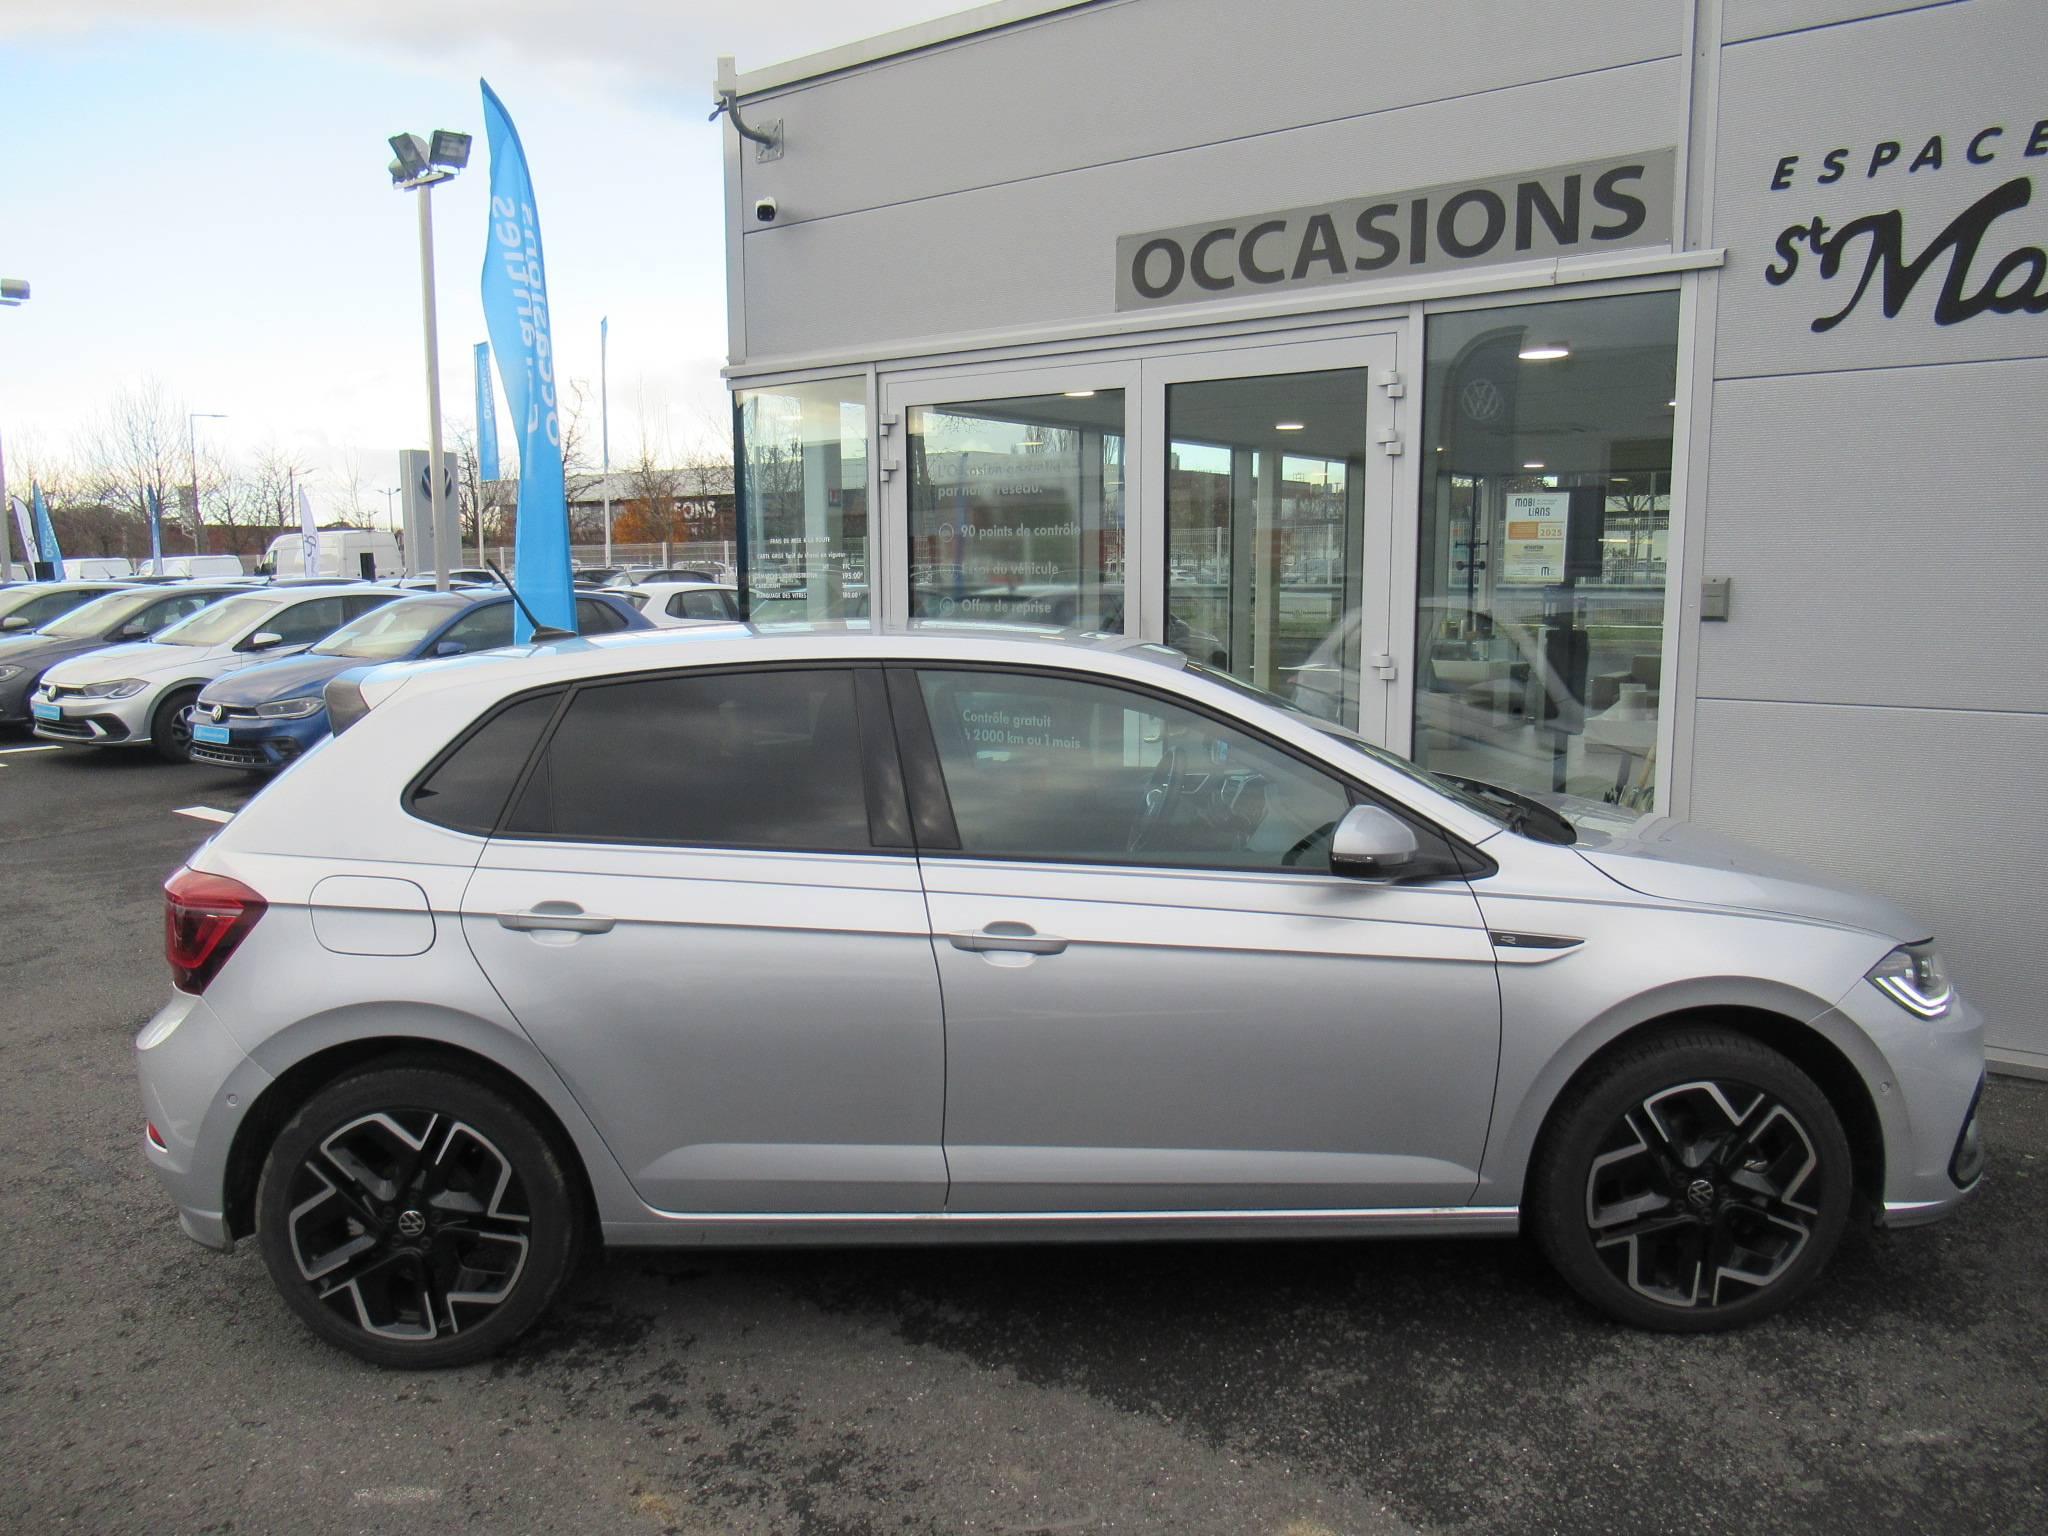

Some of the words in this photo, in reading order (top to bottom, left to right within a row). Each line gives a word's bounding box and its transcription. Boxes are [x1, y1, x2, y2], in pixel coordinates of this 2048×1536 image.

[1770, 119, 2048, 191] ESPACE
[1130, 165, 1647, 300] OCCASIONS
[937, 463, 1003, 478] L'Oasion
[938, 486, 958, 501] par
[961, 524, 976, 538] 90
[979, 523, 1013, 541] points
[1016, 522, 1031, 537] de
[1034, 522, 1081, 537] contrôle
[1539, 529, 1563, 537] 2025
[992, 560, 1008, 575] du
[1010, 559, 1059, 575] véhicule
[994, 600, 1008, 613] de
[1011, 600, 1052, 616] reprise
[962, 709, 1009, 724] Contrôle
[1013, 714, 1052, 729] gratuit
[1007, 730, 1024, 745] km
[1027, 736, 1041, 746] ou
[1044, 734, 1049, 746] 1
[1052, 736, 1081, 749] mois
